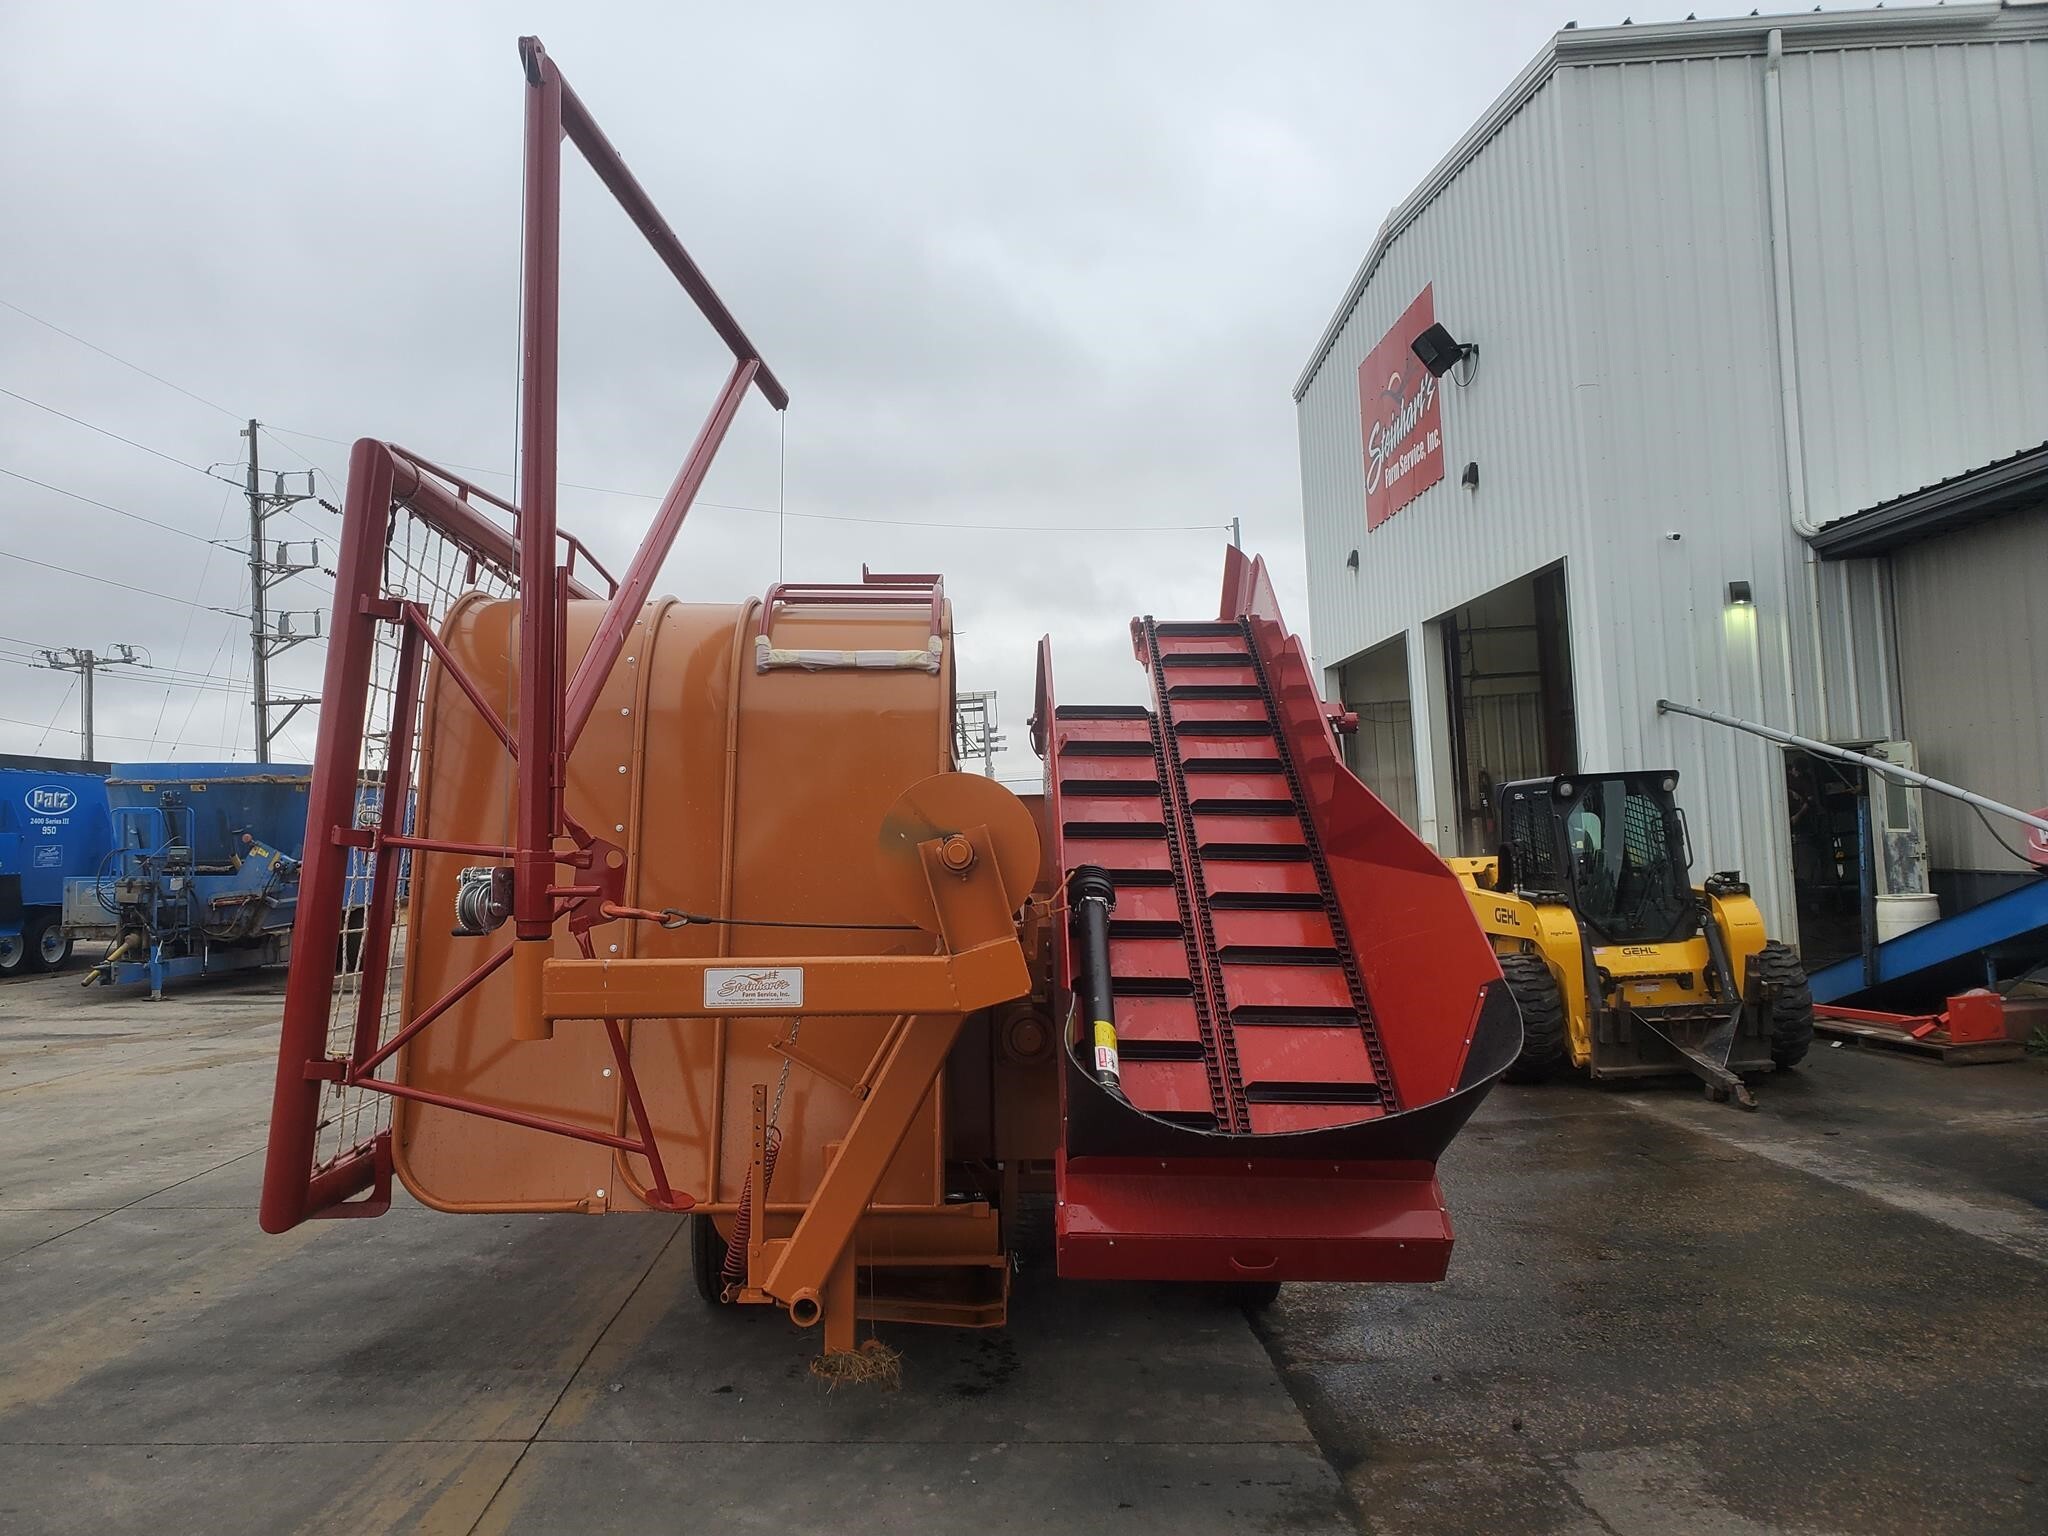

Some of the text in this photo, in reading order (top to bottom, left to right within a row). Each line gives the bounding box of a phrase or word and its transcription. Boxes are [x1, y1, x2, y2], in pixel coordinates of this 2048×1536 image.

[1366, 373, 1435, 495] Steinhart's
[1384, 428, 1441, 489] Farm Service, Inc.
[33, 790, 71, 808] Patz
[42, 826, 57, 835] 950
[1494, 907, 1521, 926] GEHL
[1622, 947, 1657, 955] GEHL
[717, 979, 790, 997] Steinhart's
